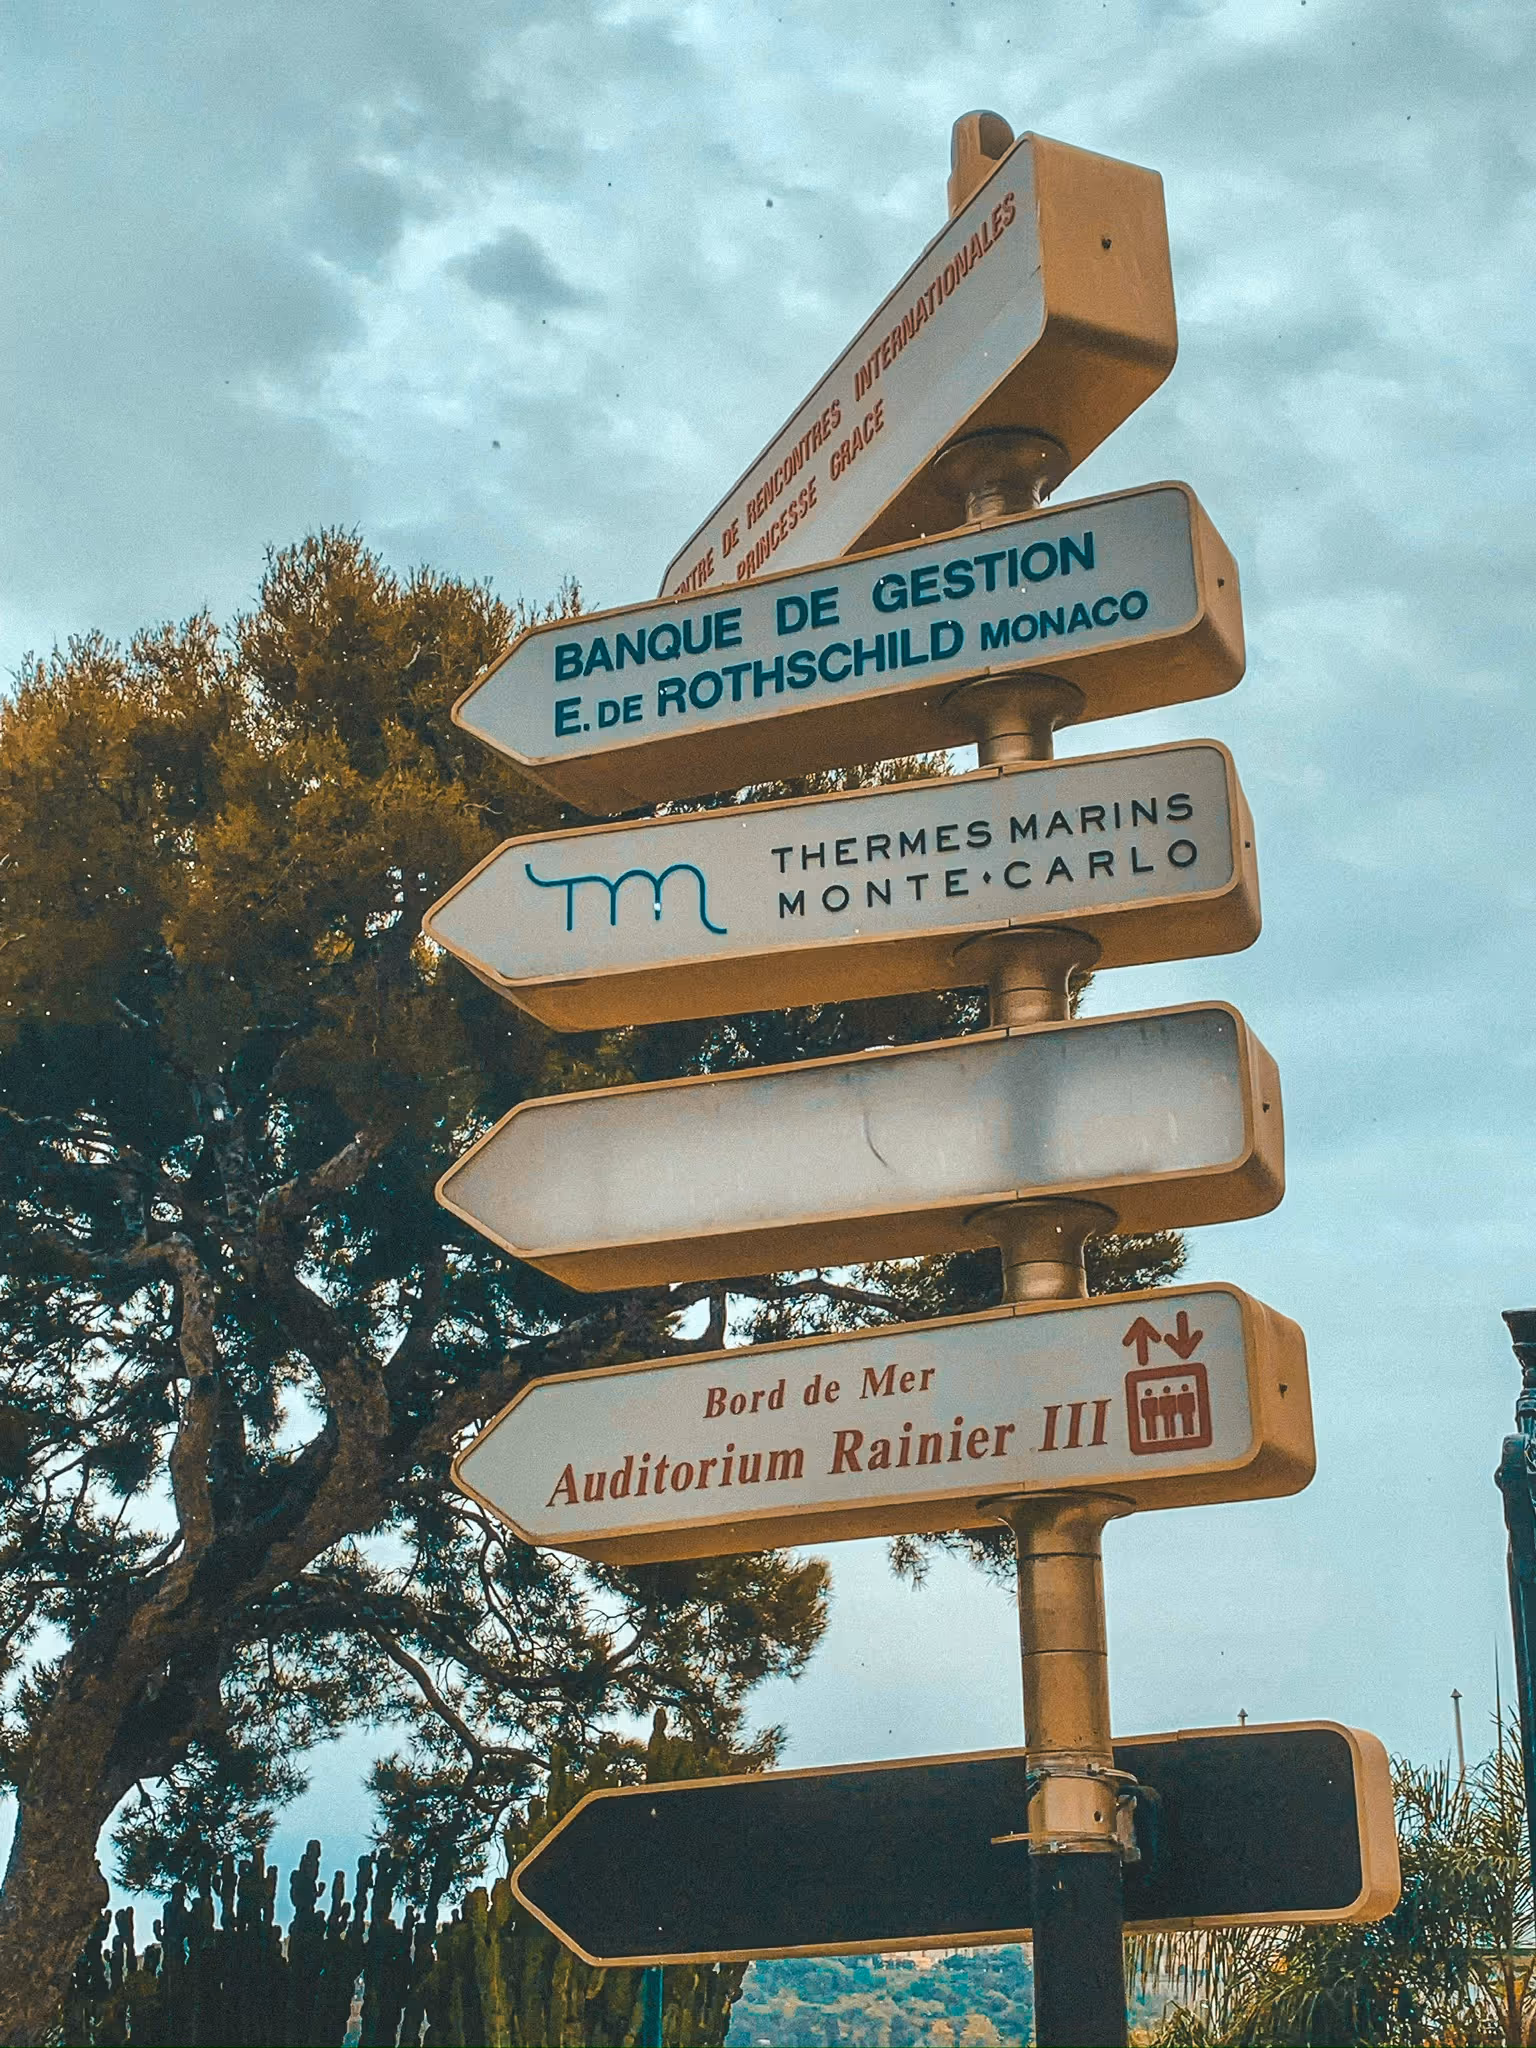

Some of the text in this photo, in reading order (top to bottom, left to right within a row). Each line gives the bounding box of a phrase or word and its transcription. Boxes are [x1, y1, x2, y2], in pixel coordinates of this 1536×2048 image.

[721, 518, 739, 558] DE
[746, 399, 841, 530] RENCONTRES
[854, 191, 1017, 402] INTERNATIONALES
[736, 398, 886, 582] PRINCESSE GRACE
[555, 531, 1095, 682] BANQUE DE GESTION
[555, 590, 1149, 737] E. DE ROTHSCHILD MONACO
[772, 793, 1196, 875] THERMES MARINS
[545, 1398, 1112, 1508] Auditorium Rainier III
[703, 1363, 935, 1419] Bord de Mer
